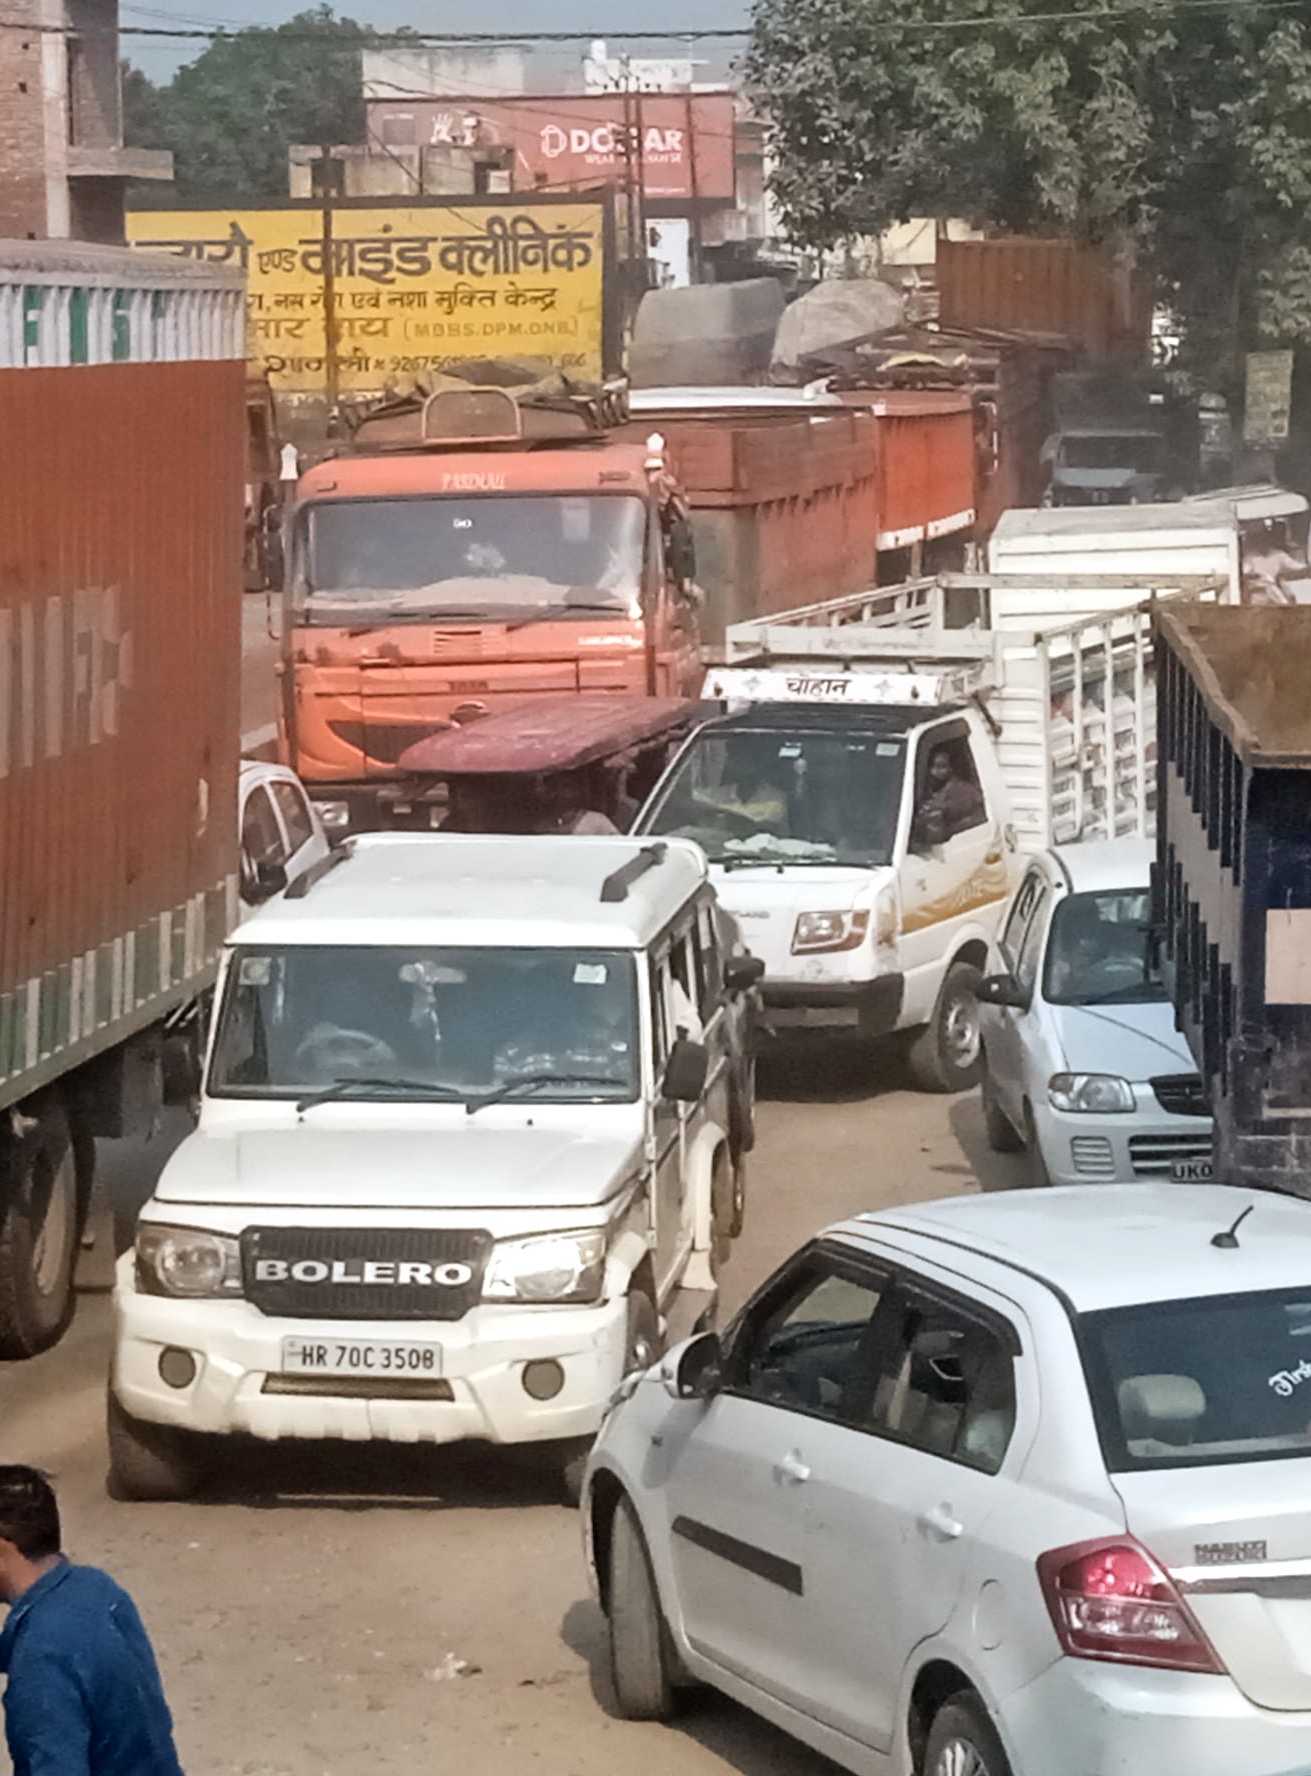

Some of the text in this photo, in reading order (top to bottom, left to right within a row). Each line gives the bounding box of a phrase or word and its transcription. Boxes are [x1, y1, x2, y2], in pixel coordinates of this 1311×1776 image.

[571, 126, 683, 154] DOAR
[255, 1260, 472, 1286] BOLERO
[301, 1344, 436, 1370] HR 70C 3508
